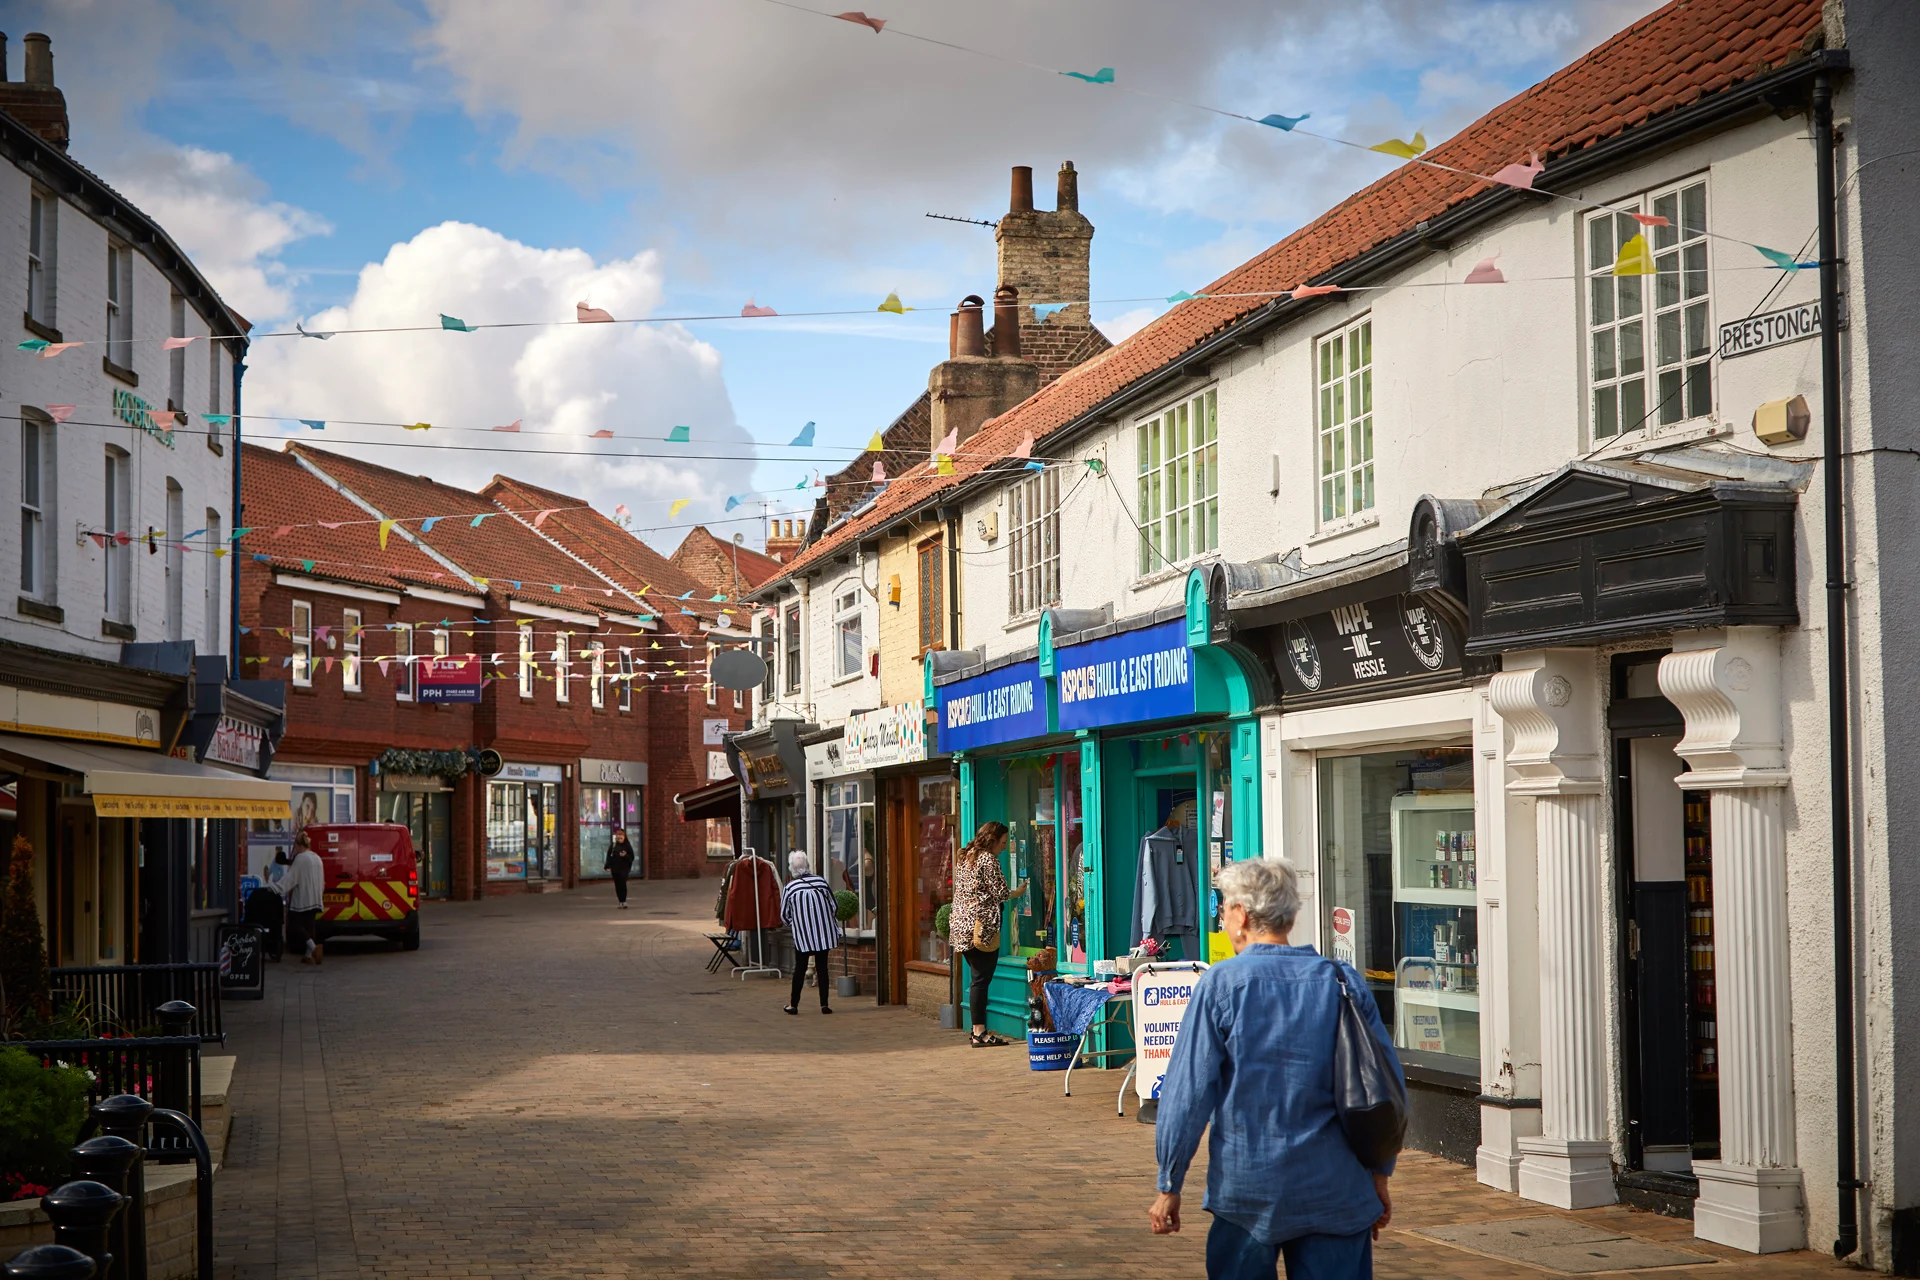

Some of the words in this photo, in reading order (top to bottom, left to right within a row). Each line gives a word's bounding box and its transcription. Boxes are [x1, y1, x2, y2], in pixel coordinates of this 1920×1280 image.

[1331, 602, 1373, 636] VAPE
[1406, 606, 1427, 625] VAPE
[1291, 637, 1309, 653] VAPE
[1351, 633, 1373, 658] INC
[1061, 667, 1088, 704] RSPCA
[1096, 661, 1119, 698] HULL
[1120, 659, 1128, 694] &
[1129, 654, 1153, 692] EAST
[1154, 646, 1188, 688] RIDING
[1352, 658, 1387, 679] HESSLE
[422, 689, 442, 697] PPH
[948, 698, 966, 729] RSPCA
[972, 692, 987, 724] HULL
[987, 690, 993, 720] &
[993, 686, 1010, 719] EAST
[1010, 680, 1033, 715] RIDING
[1411, 772, 1442, 780] LEGEND
[1160, 986, 1192, 999] RSPCA
[1144, 1022, 1182, 1033] VOLUNTE
[1144, 1035, 1175, 1046] NEEDED
[1046, 1053, 1062, 1061] HELP
[1144, 1049, 1171, 1059] THANK
